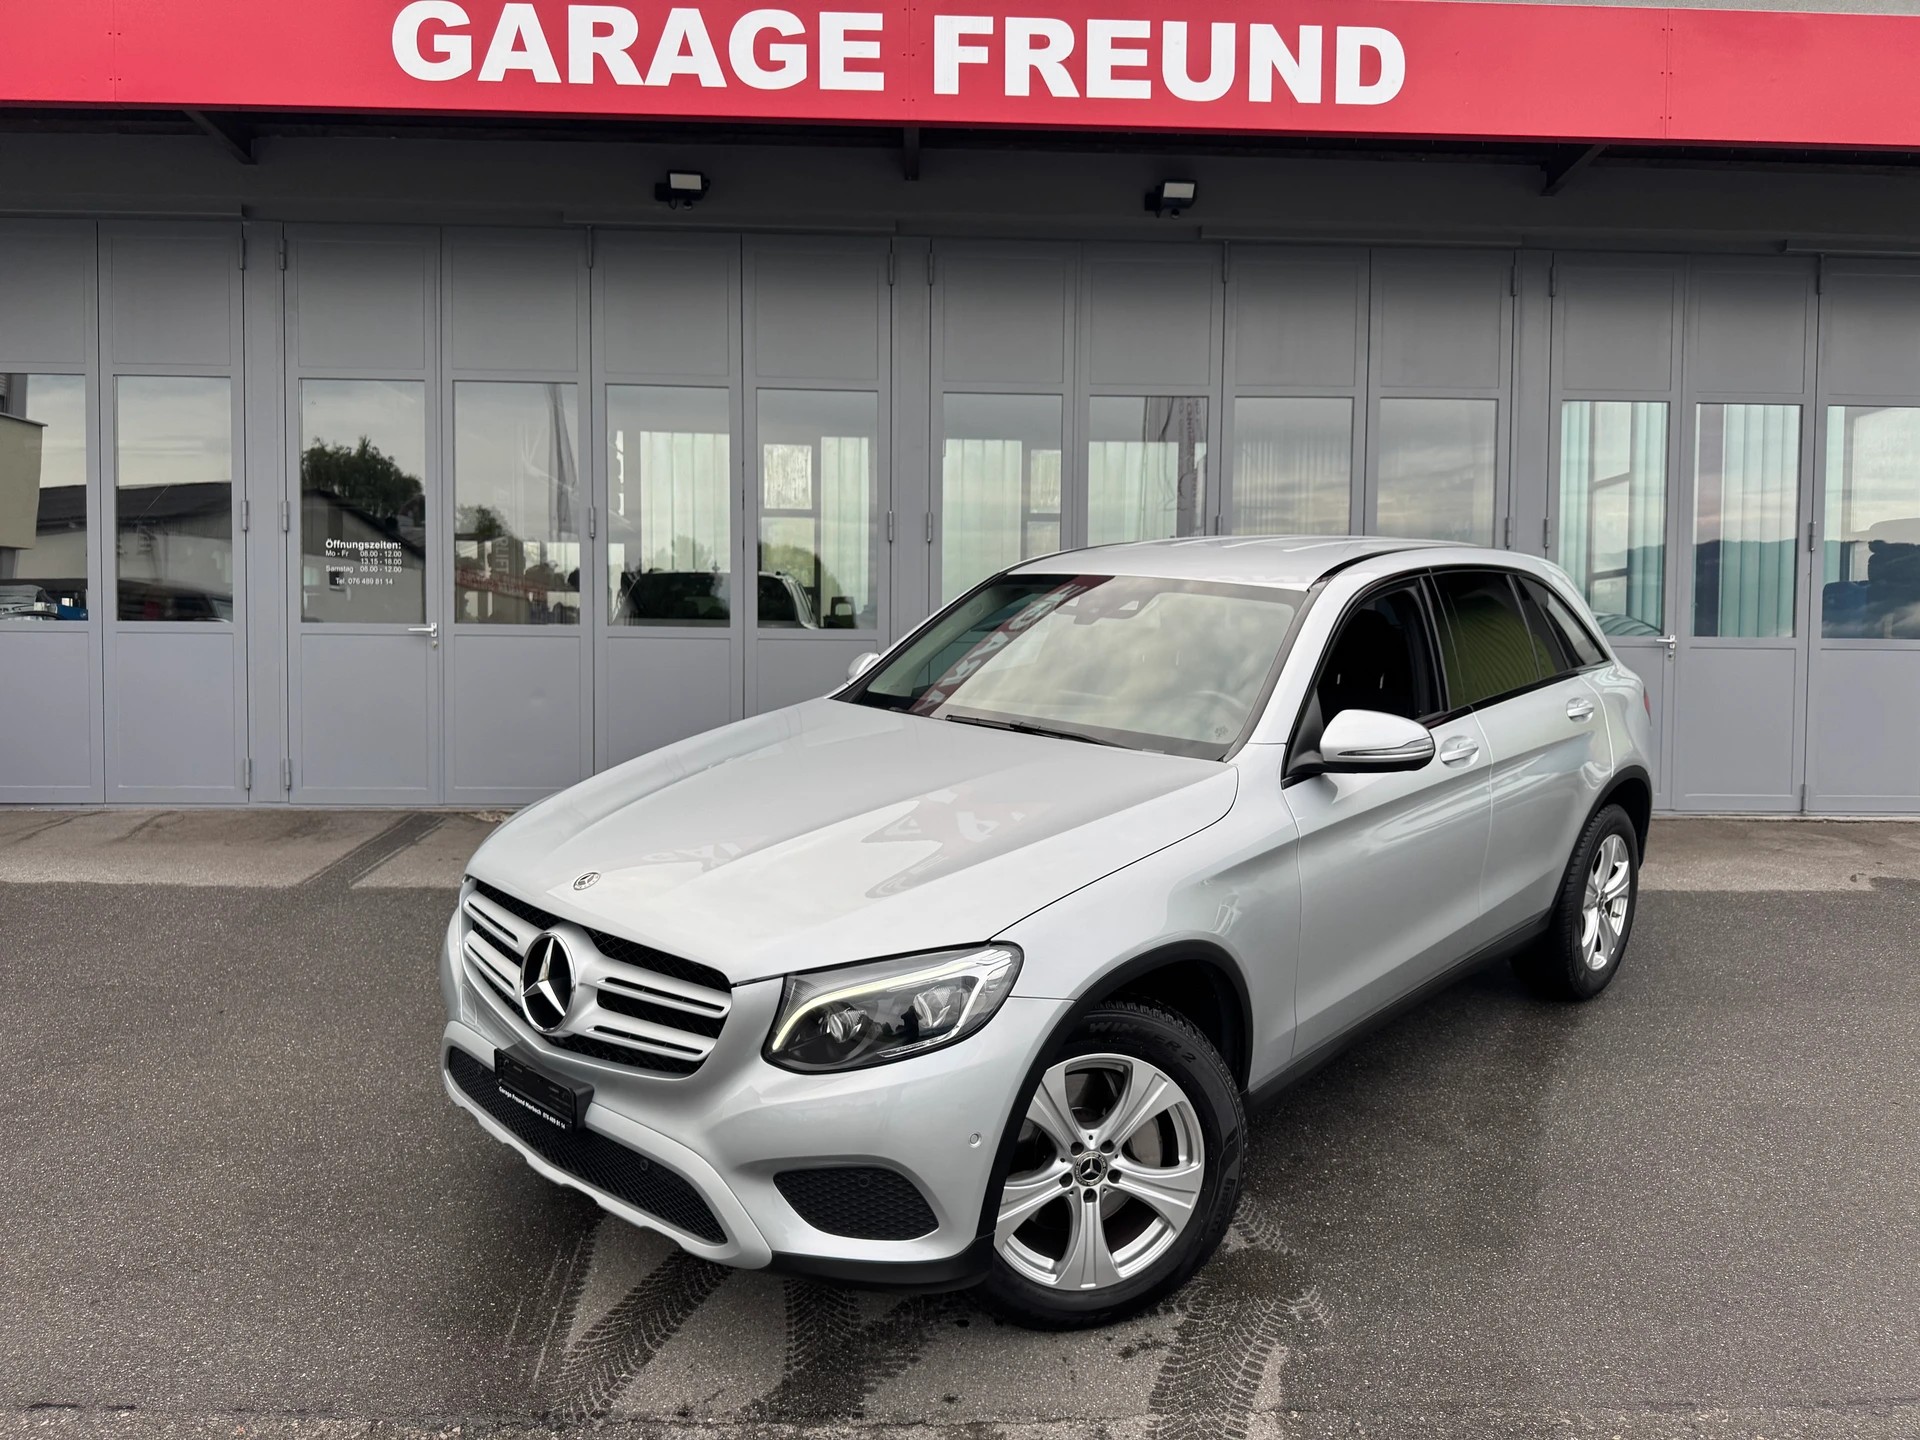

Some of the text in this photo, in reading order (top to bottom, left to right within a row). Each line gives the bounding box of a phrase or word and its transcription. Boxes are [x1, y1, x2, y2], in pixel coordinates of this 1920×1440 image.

[392, 0, 1406, 105] GARAGE FREUND
[326, 538, 402, 550] Öffnungszeiten:
[326, 565, 353, 573] Samstag
